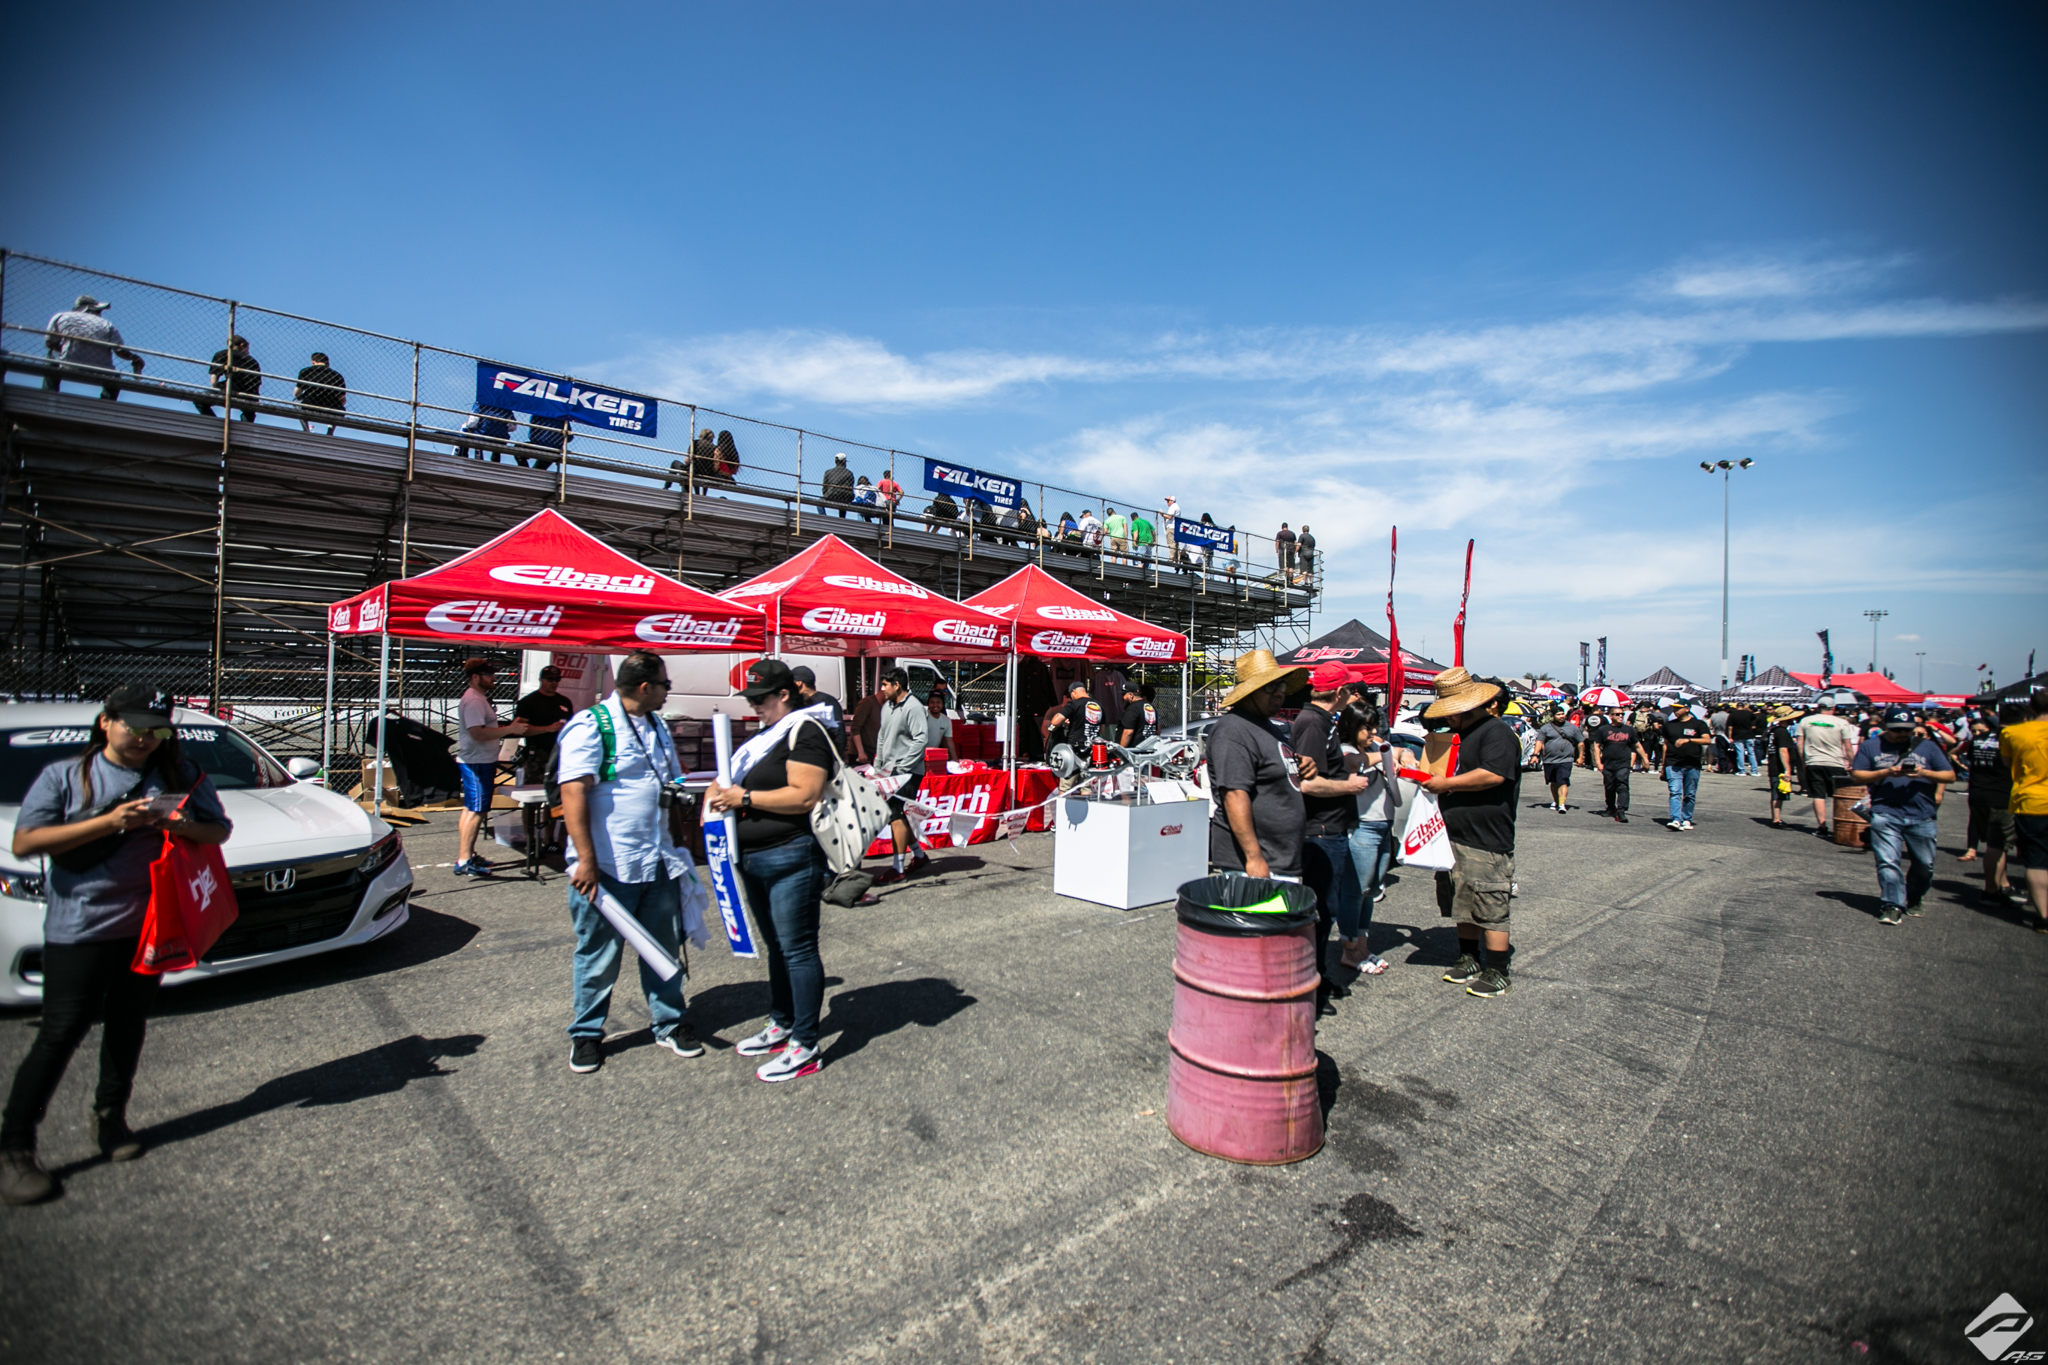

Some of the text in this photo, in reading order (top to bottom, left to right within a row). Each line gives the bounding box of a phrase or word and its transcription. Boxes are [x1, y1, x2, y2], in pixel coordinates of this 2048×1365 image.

[490, 372, 645, 419] FALKEN
[608, 416, 642, 431] TIRES
[932, 465, 1016, 496] FALKEN
[994, 495, 1013, 505] TIRES
[1179, 521, 1230, 543] FALKEN
[489, 564, 655, 595] Eibach
[823, 575, 928, 599] Eibach
[425, 600, 563, 637] Eibach
[802, 607, 886, 636] Eibach
[1036, 605, 1117, 622] Eibach
[635, 613, 741, 646] Eibach
[933, 619, 998, 647] Eibach
[1031, 630, 1093, 655] Eibach
[1125, 637, 1177, 659] Eibach
[1404, 810, 1446, 856] Eibac
[705, 833, 742, 943] FALKEN
